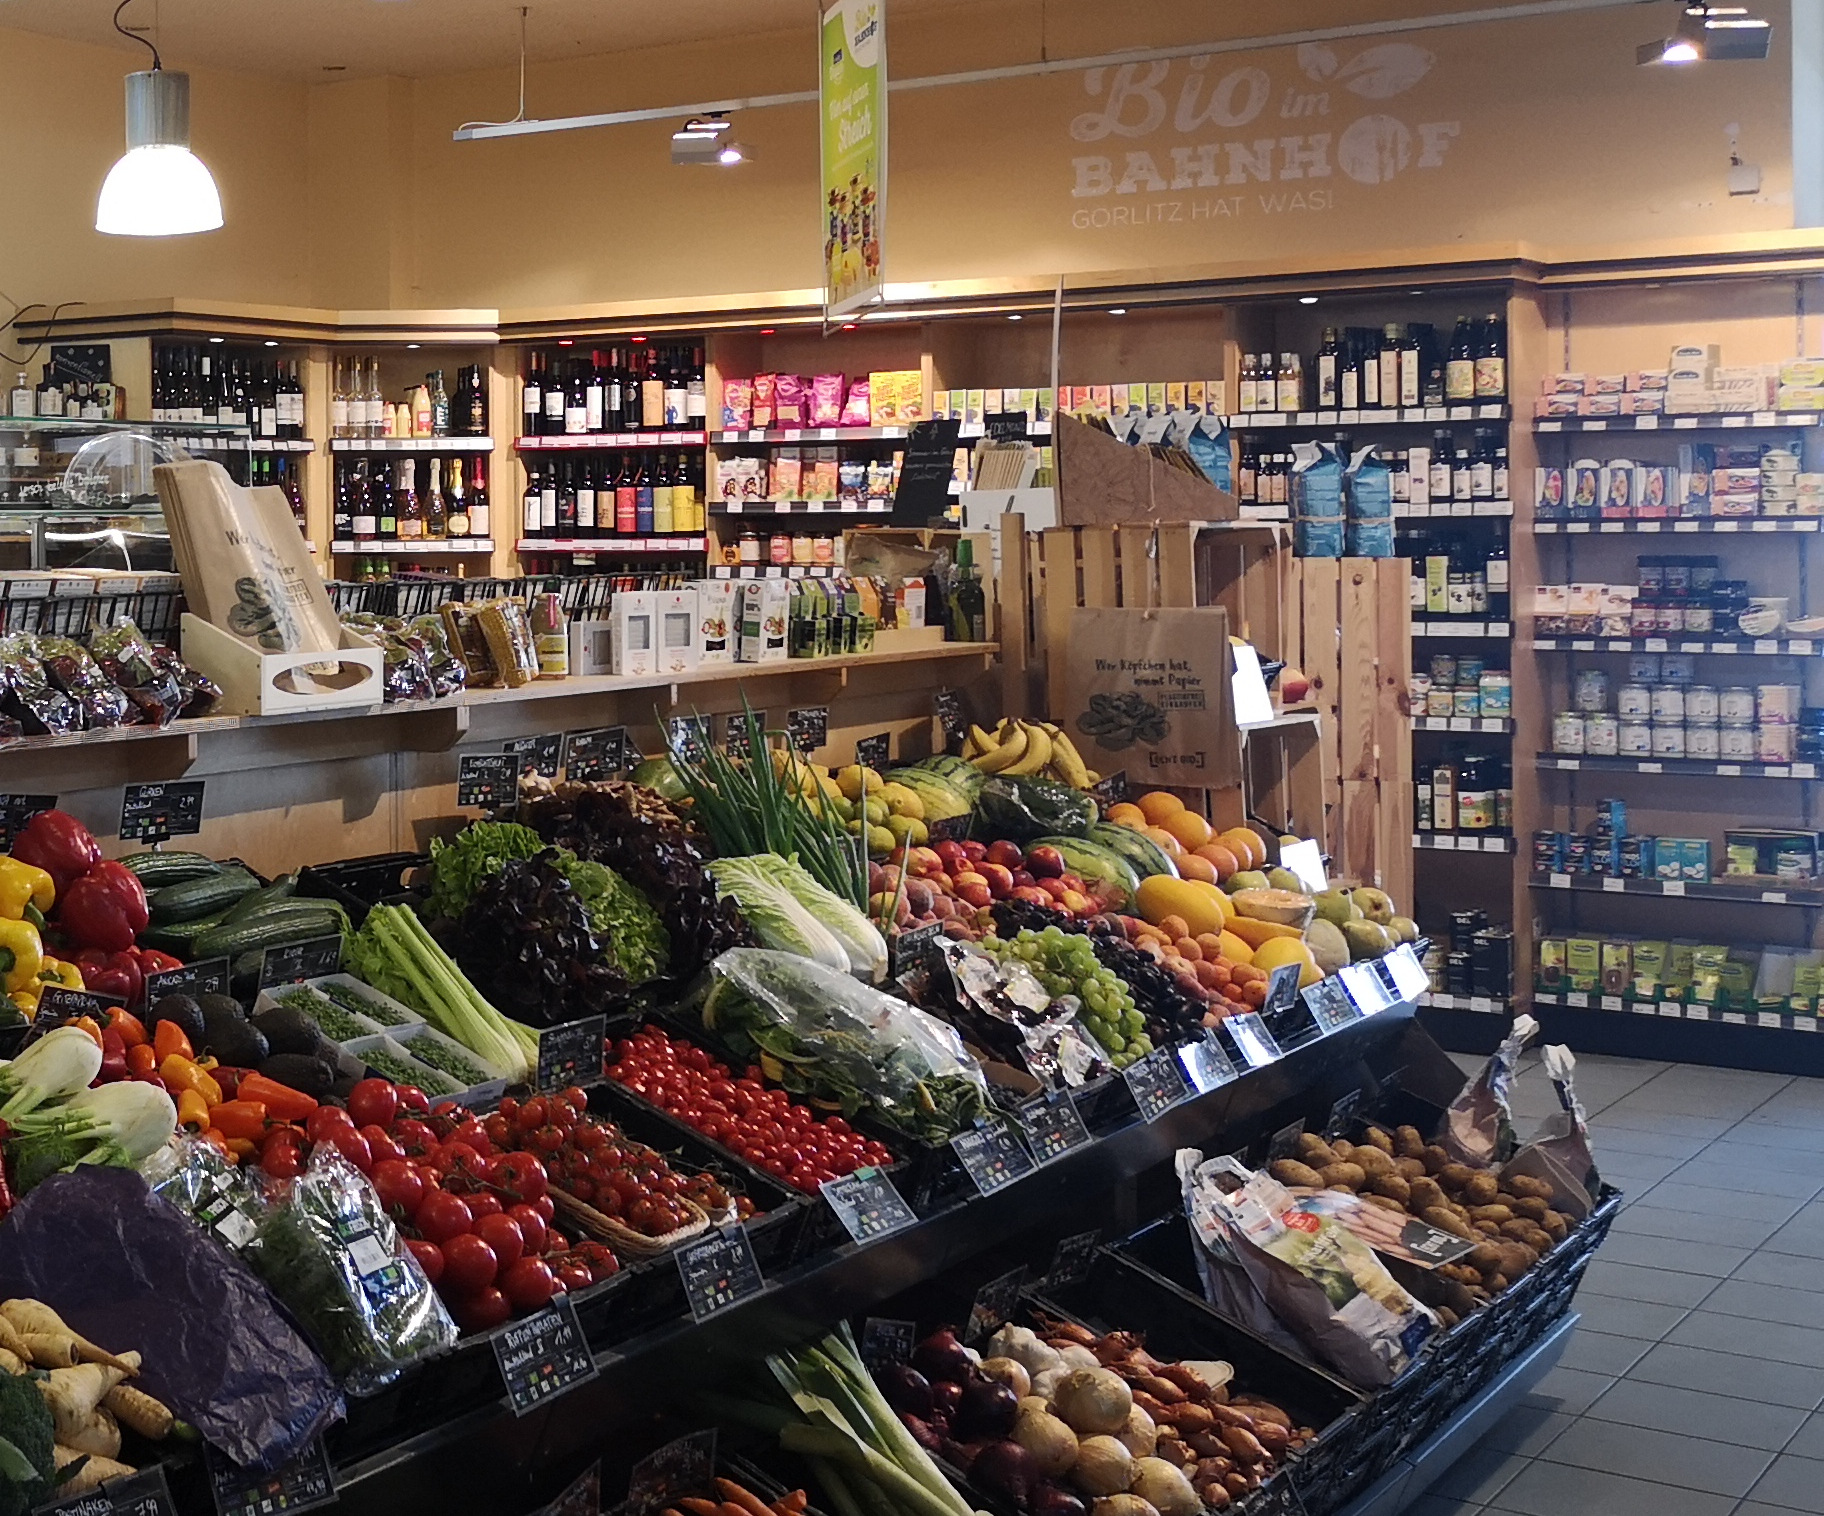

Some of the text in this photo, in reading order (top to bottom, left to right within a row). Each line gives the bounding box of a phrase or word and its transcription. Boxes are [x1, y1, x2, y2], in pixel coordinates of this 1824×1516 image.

[1069, 45, 1330, 142] Bio im
[1072, 114, 1461, 198] BAHNHOF
[1192, 197, 1245, 220] HAT
[1259, 190, 1333, 212] WAS!
[1095, 658, 1117, 671] Wer
[1168, 673, 1201, 690] Papier
